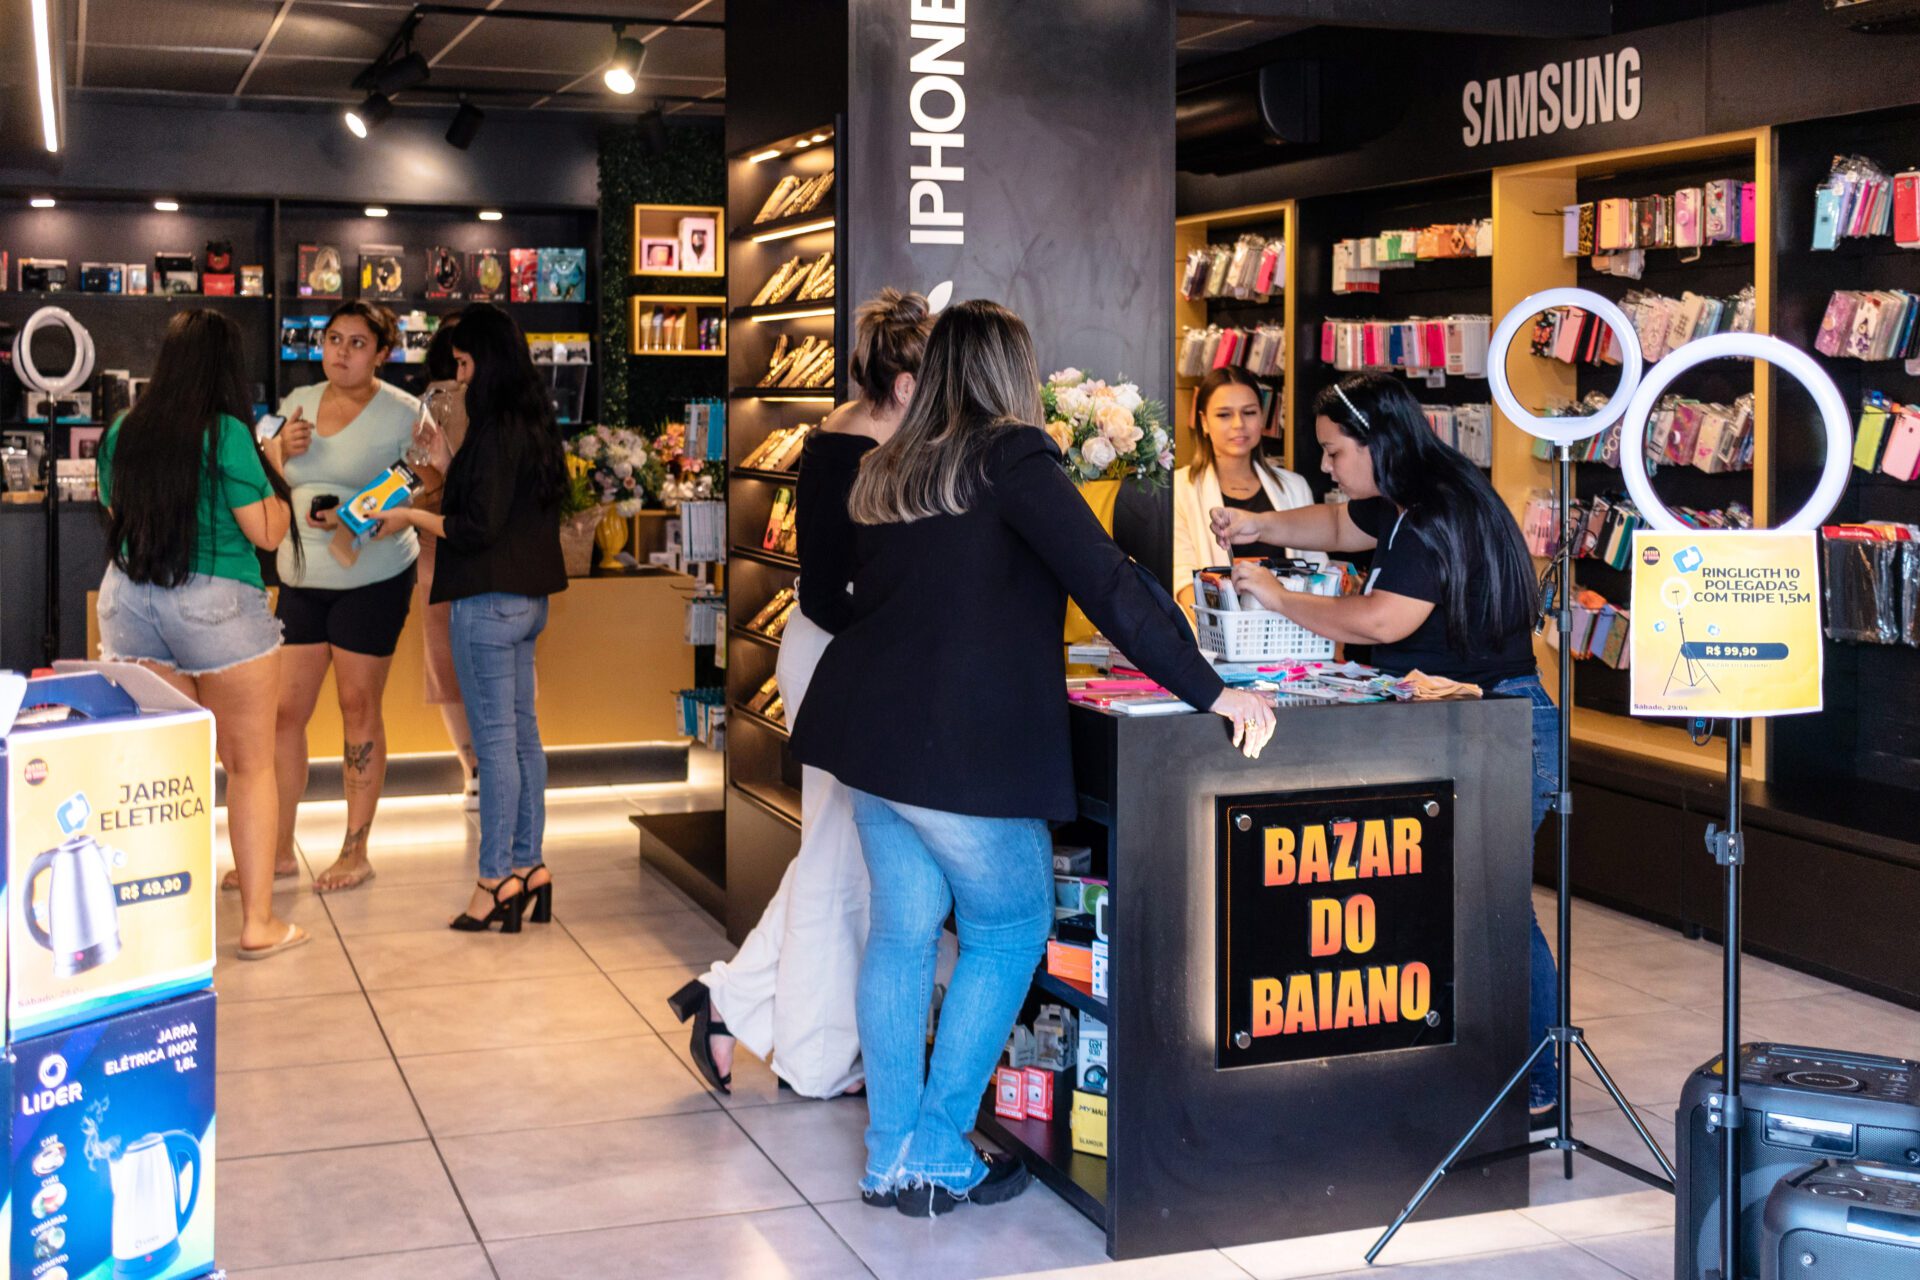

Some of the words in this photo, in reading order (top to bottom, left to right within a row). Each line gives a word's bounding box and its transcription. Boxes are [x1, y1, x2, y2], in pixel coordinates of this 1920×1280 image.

[1462, 46, 1641, 148] SAMSUNG
[910, 0, 966, 244] IPHONE
[1702, 567, 1780, 578] RINGLIGTH
[1785, 568, 1800, 579] 10
[1705, 579, 1798, 591] POLEGADAS
[1693, 591, 1728, 602] COM
[1779, 593, 1811, 605] 1,5M
[1705, 645, 1721, 656] R$
[1724, 646, 1758, 657] 99,90
[118, 775, 195, 805] JARRA
[1263, 816, 1423, 888] BAZAR
[120, 883, 140, 900] R$
[141, 876, 182, 896] 49,90
[1310, 893, 1376, 958] DO
[1252, 961, 1430, 1038] BAIANO
[157, 1021, 198, 1044] JARRA
[104, 1047, 166, 1076] ELÉTRICA
[167, 1038, 198, 1058] INOX
[22, 1081, 84, 1116] LIDER
